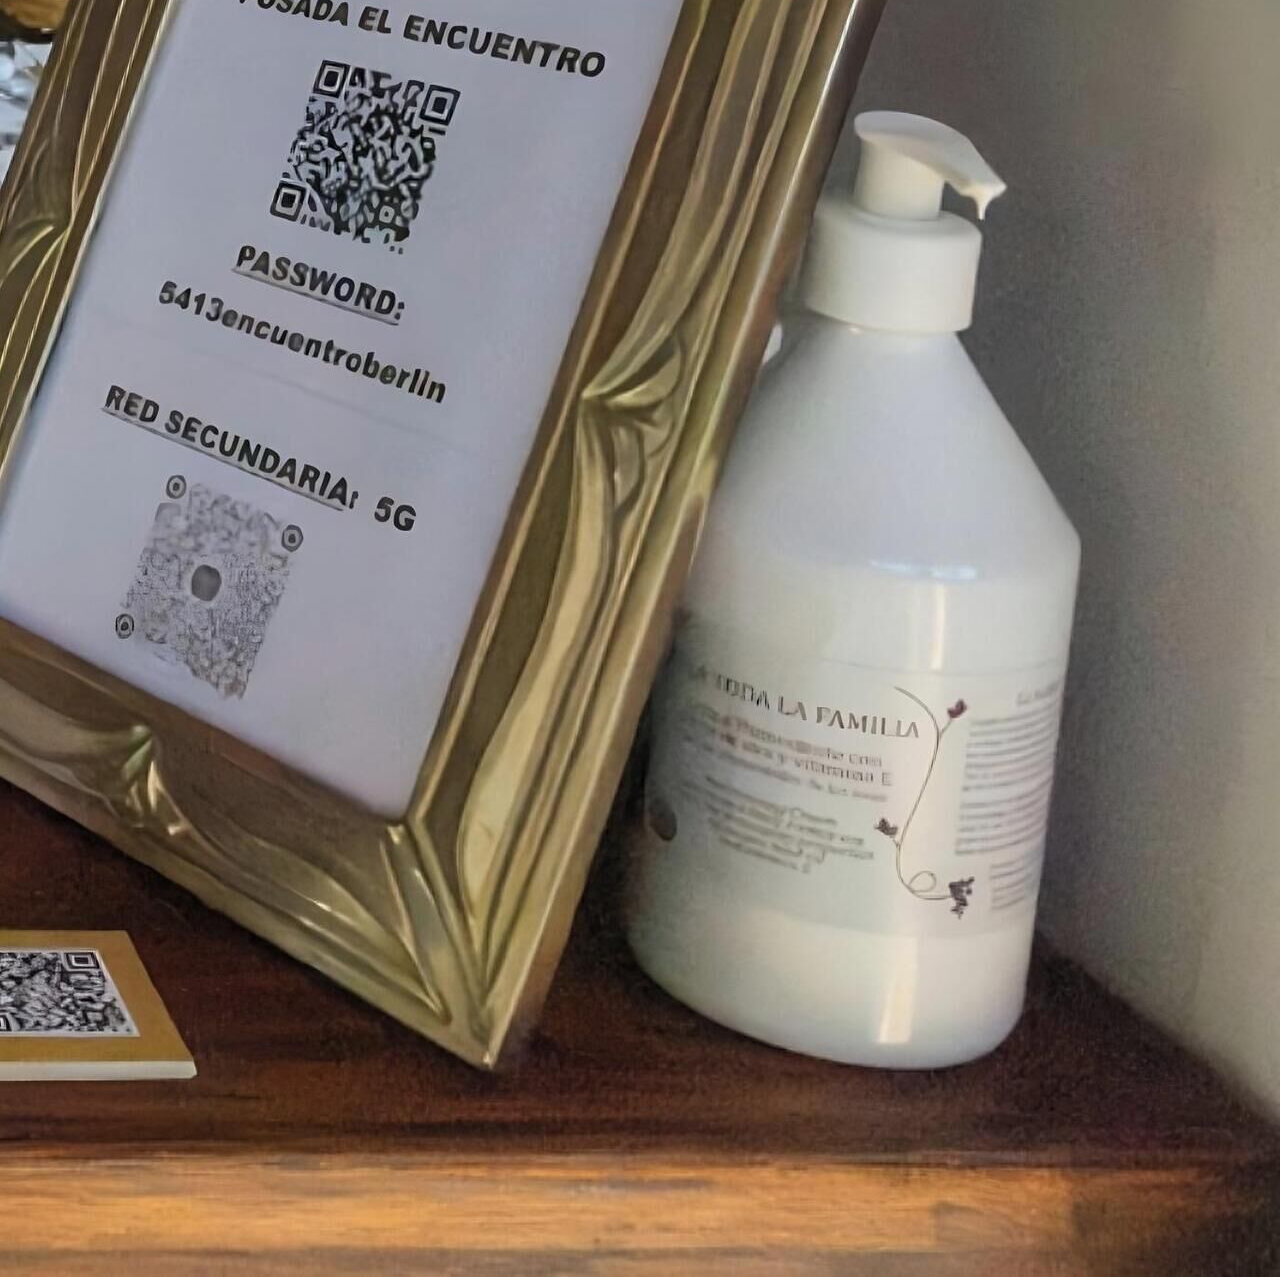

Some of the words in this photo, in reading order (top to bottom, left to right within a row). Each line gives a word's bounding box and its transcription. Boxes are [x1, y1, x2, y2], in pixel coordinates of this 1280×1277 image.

[358, 6, 393, 35] EL
[402, 14, 606, 78] ENCUENTRO
[235, 245, 406, 322] PASSWORD:
[103, 384, 160, 424] RED
[374, 496, 418, 533] 5G
